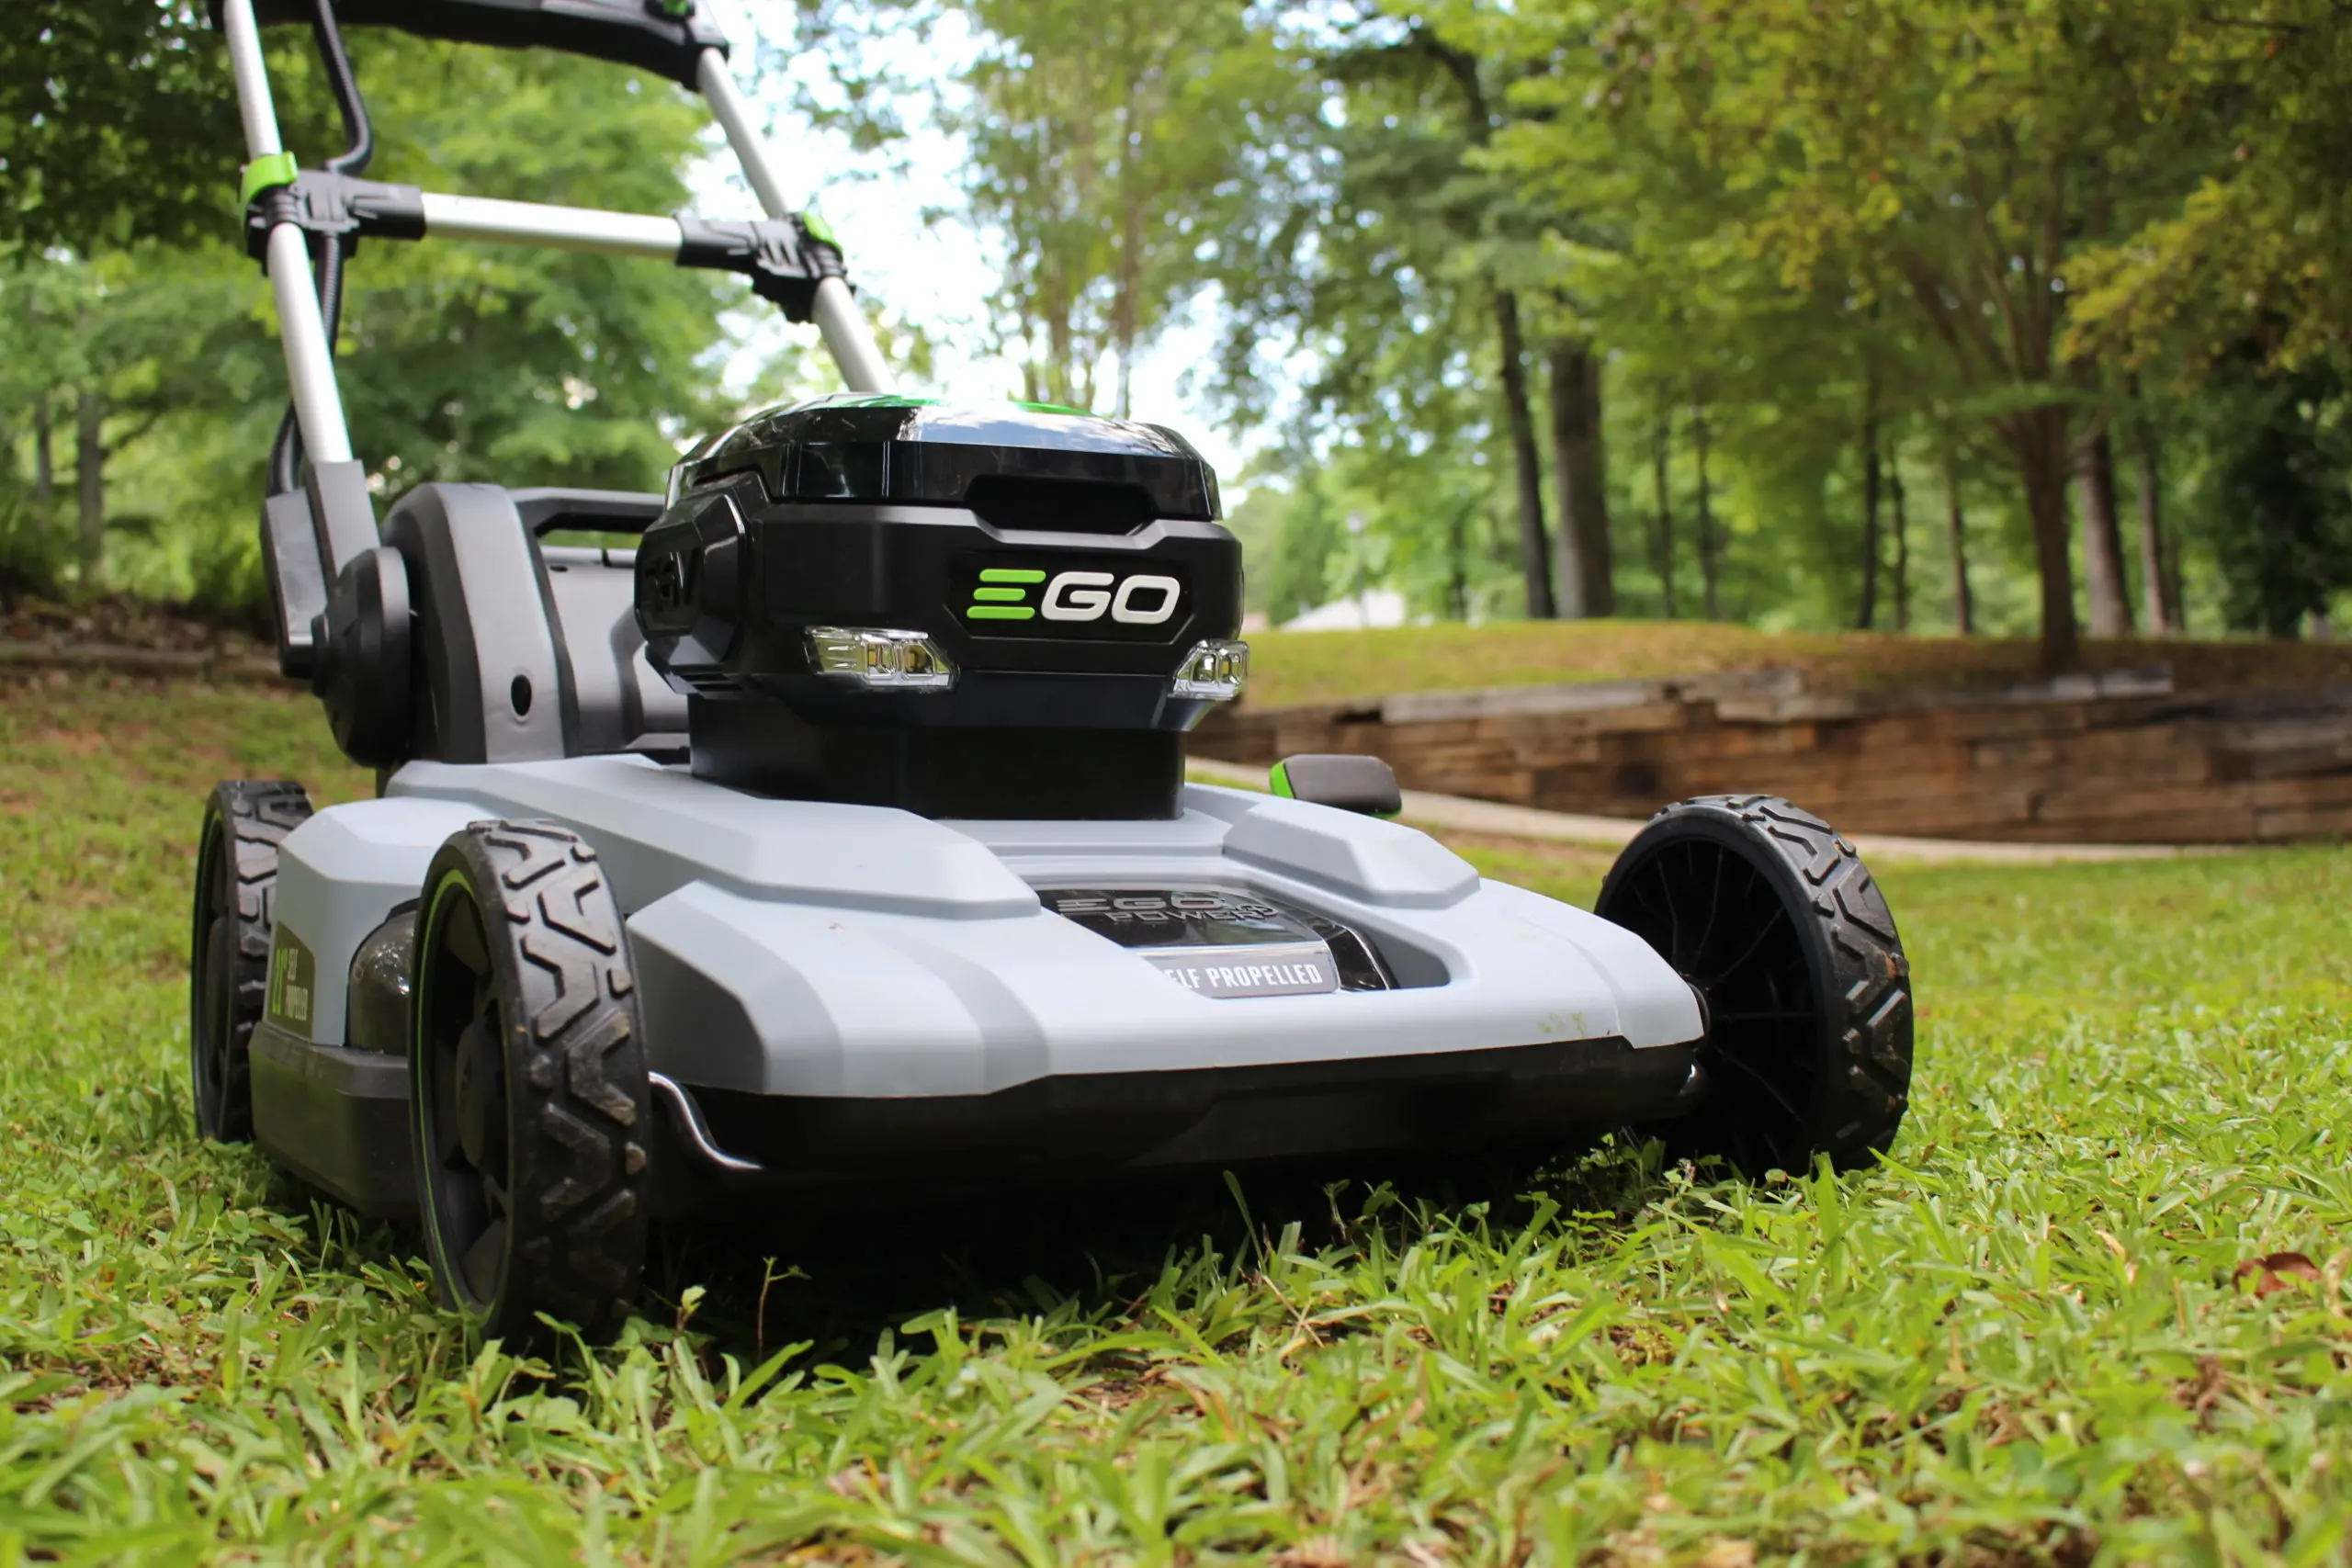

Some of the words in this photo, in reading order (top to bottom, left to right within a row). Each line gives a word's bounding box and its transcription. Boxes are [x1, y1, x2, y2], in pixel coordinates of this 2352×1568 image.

[967, 569, 1181, 625] EGO
[1057, 897, 1224, 912] EGO
[1165, 968, 1202, 988] ELF
[1204, 964, 1323, 987] PROPELLED
